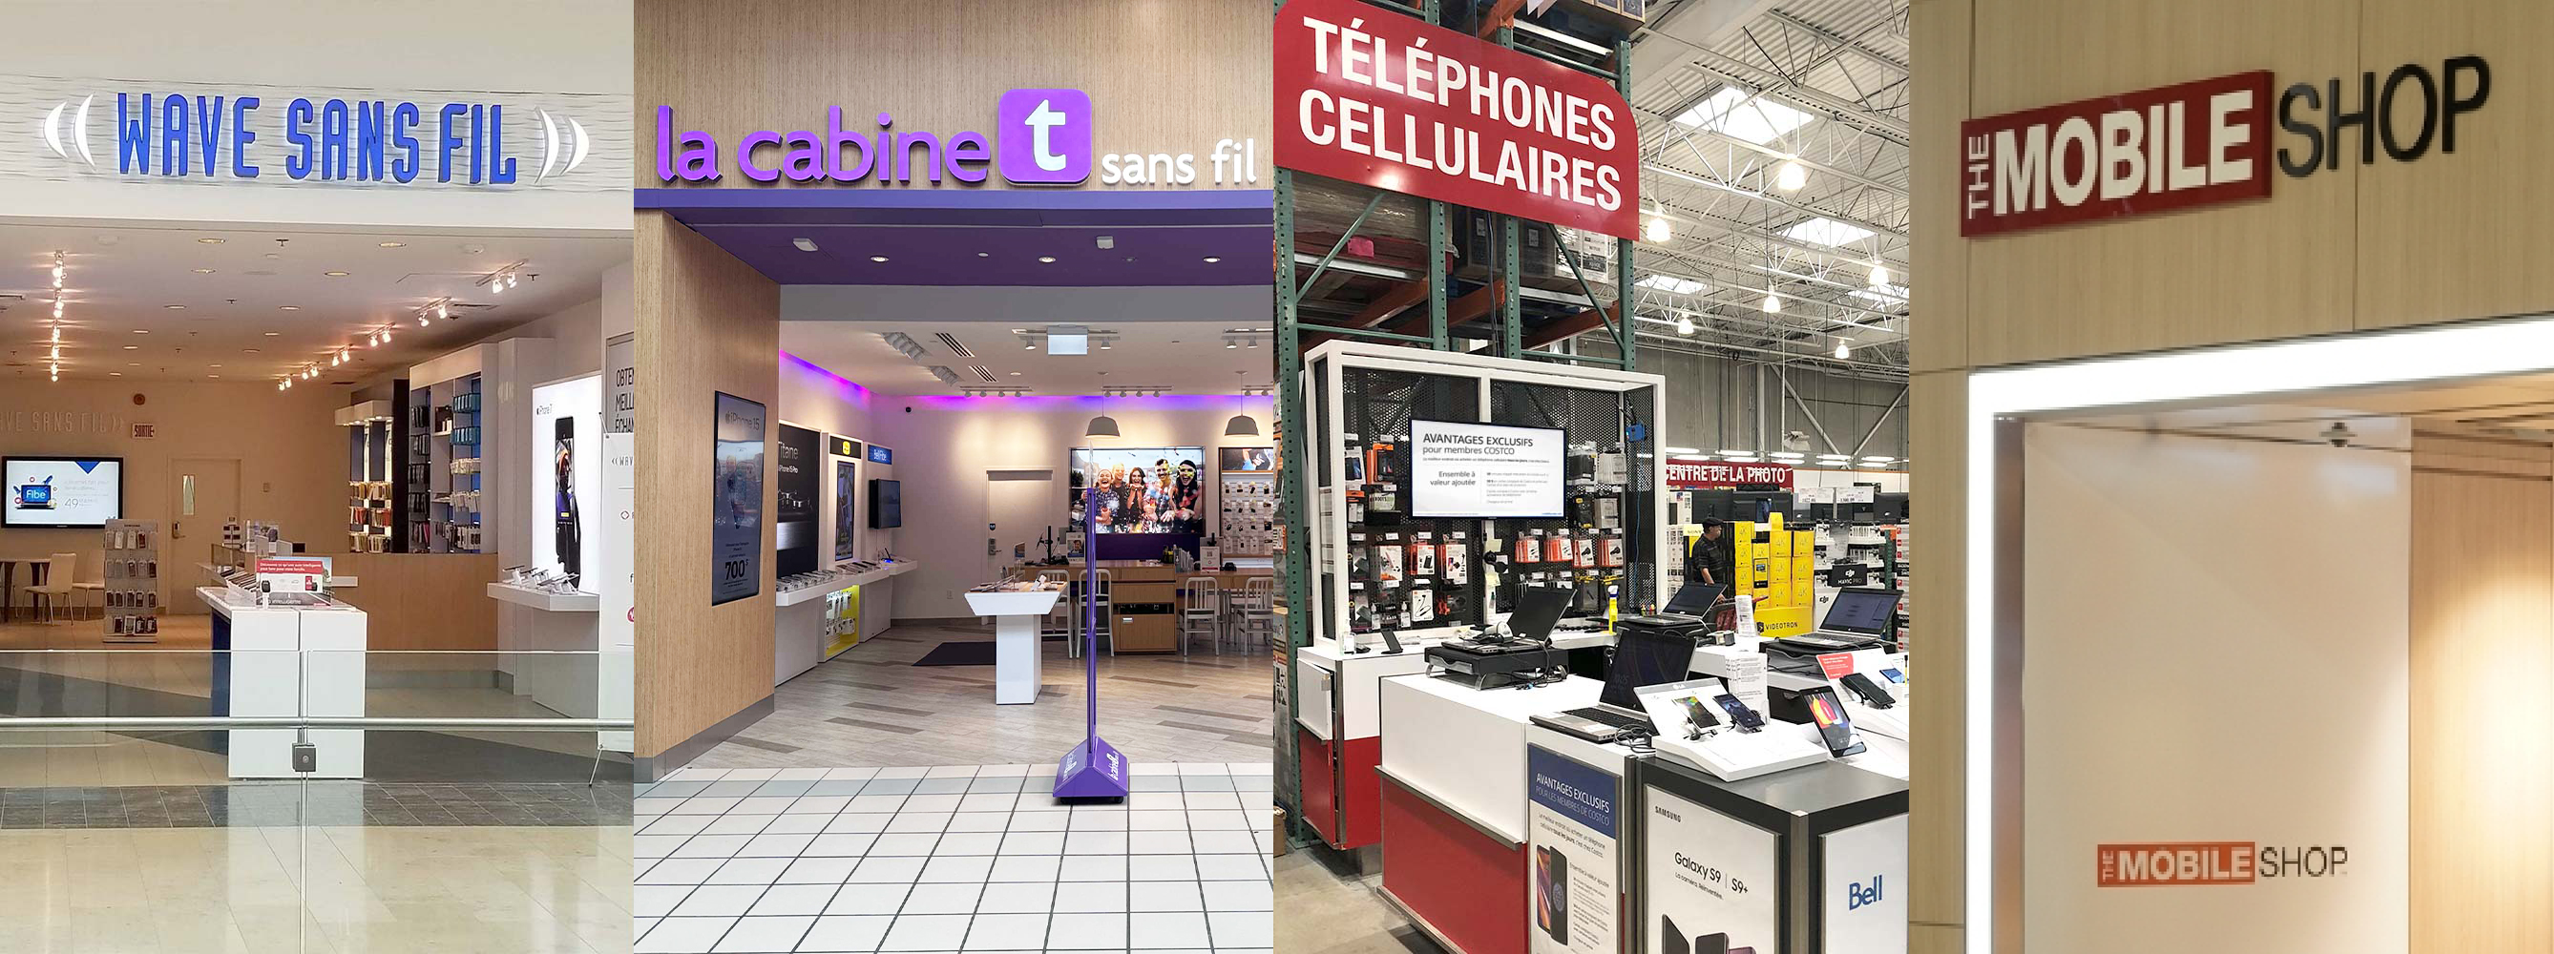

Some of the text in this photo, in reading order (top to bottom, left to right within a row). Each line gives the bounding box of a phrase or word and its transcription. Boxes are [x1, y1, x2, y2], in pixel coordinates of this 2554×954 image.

[1303, 16, 1616, 152] TÉLÉPHONES
[117, 92, 517, 185] WAVE SANS FIL
[656, 99, 1258, 186] la cabine t sans fil
[1299, 89, 1622, 212] CELLULAIRES
[1968, 54, 2492, 220] THE MOBILE SHOP
[32, 411, 73, 432] SANS
[81, 412, 107, 433] FIL
[730, 412, 760, 431] iPhone 15
[1423, 433, 1533, 447] AVANTAGES EXCLUSIFS
[1423, 446, 1515, 455] pour membres COSTCO
[1451, 479, 1476, 488] ajoutée
[1712, 466, 1727, 481] DE
[1730, 466, 1744, 482] LA
[1747, 467, 1786, 483] PHOTO
[1765, 622, 1798, 630] VIDEOTRON
[1536, 773, 1610, 813] AVANTAGES EXCLUSIFS
[1536, 786, 1610, 826] POUR LES MEMBRES DE COSTCO
[1655, 805, 1682, 823] SAMSUNG
[1674, 852, 1722, 884] Galaxy S9
[2102, 846, 2349, 882] THE MOBILE SHOP
[1731, 878, 1749, 894] S9+
[1849, 874, 1883, 911] Bell
